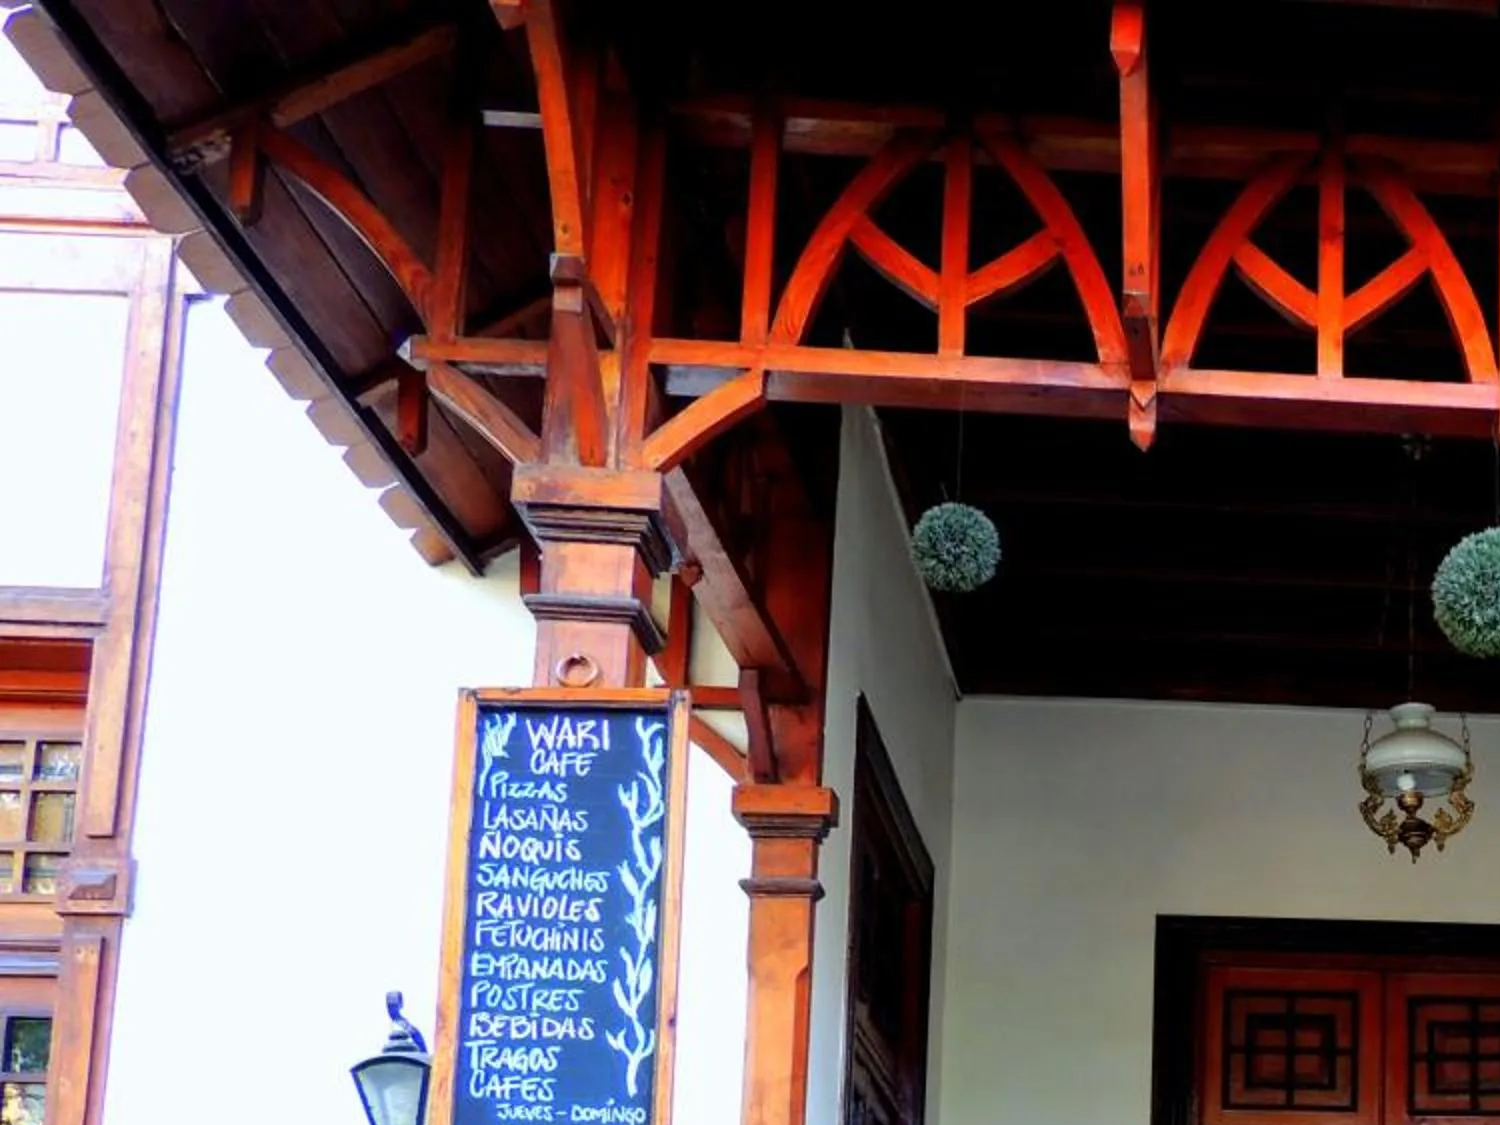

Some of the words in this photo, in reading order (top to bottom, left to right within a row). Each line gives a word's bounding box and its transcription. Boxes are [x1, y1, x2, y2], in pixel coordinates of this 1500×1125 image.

[526, 715, 610, 751] WARI
[530, 750, 597, 777] CAFE
[482, 800, 589, 832] LASAÑAS
[476, 863, 611, 897] SANGUCHES
[476, 892, 603, 922] RAVIOLES
[471, 951, 609, 984] EMPANADAS
[471, 980, 584, 1012] POSTRES
[464, 1040, 561, 1071] TRAGOS
[469, 1069, 557, 1102] CAFES
[496, 1103, 553, 1122] JUEVES
